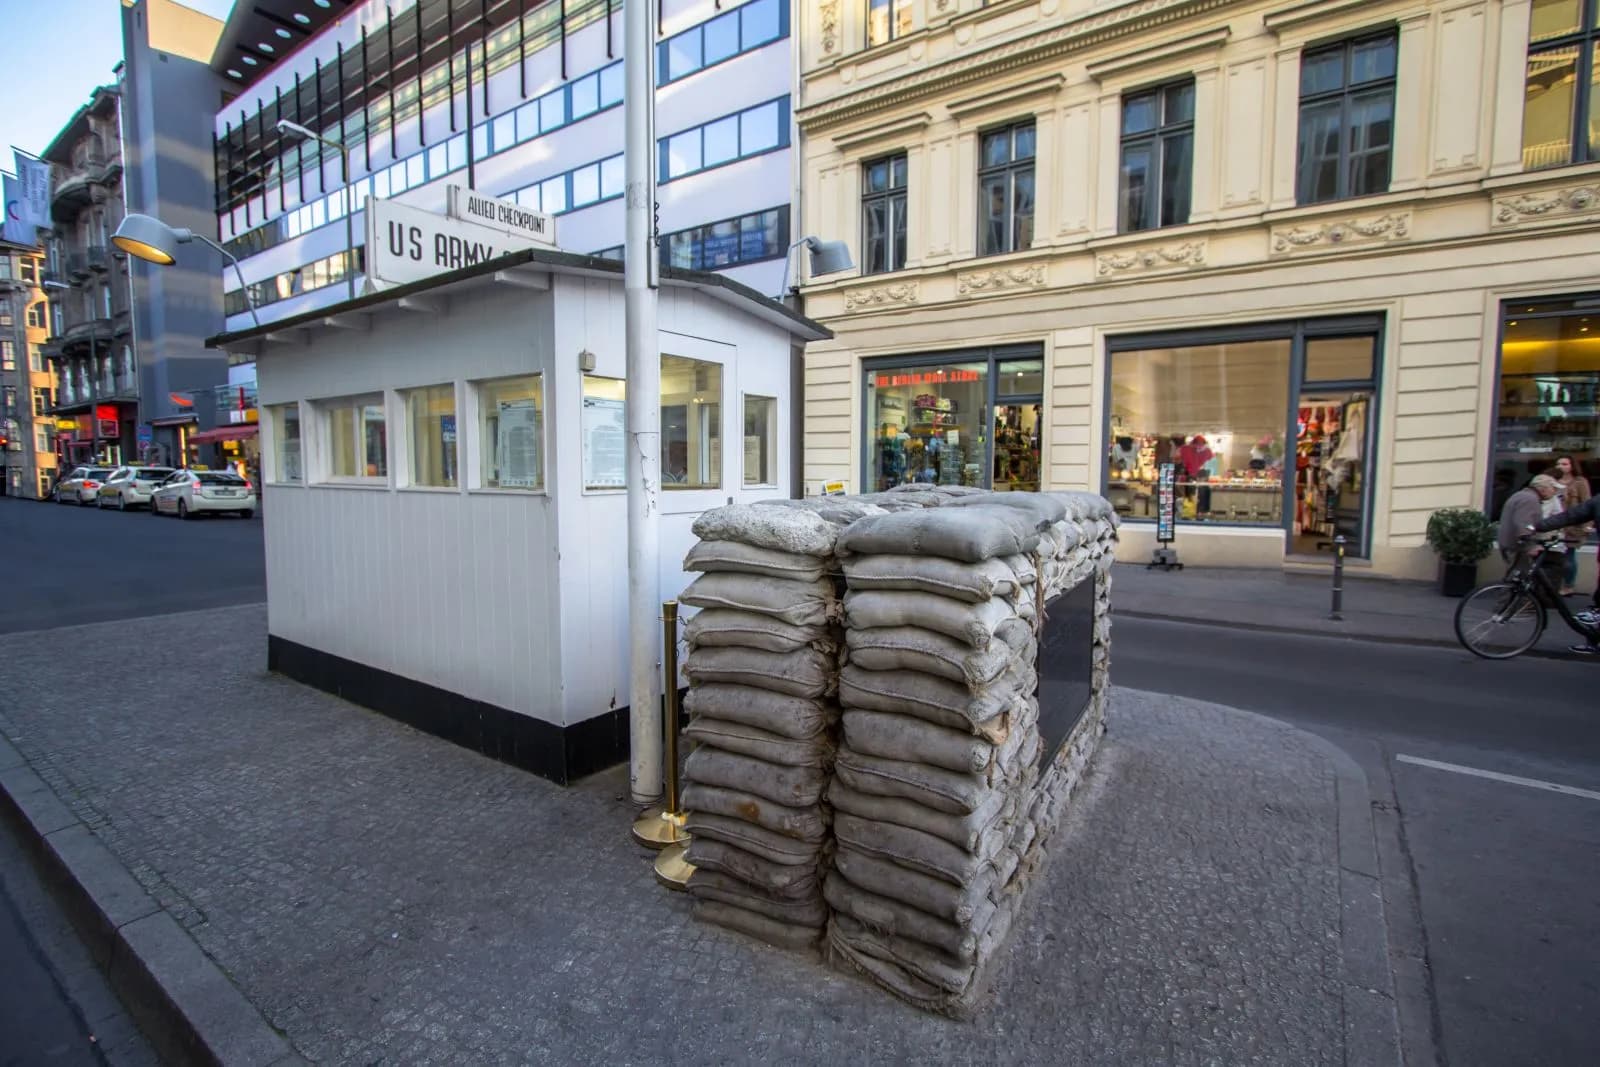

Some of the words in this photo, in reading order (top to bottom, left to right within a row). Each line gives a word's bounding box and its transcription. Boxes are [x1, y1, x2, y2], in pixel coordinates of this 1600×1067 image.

[468, 196, 495, 220] ALLIED
[499, 204, 546, 235] CHECKPOINT
[389, 220, 422, 261] US
[434, 233, 493, 270] ARMY
